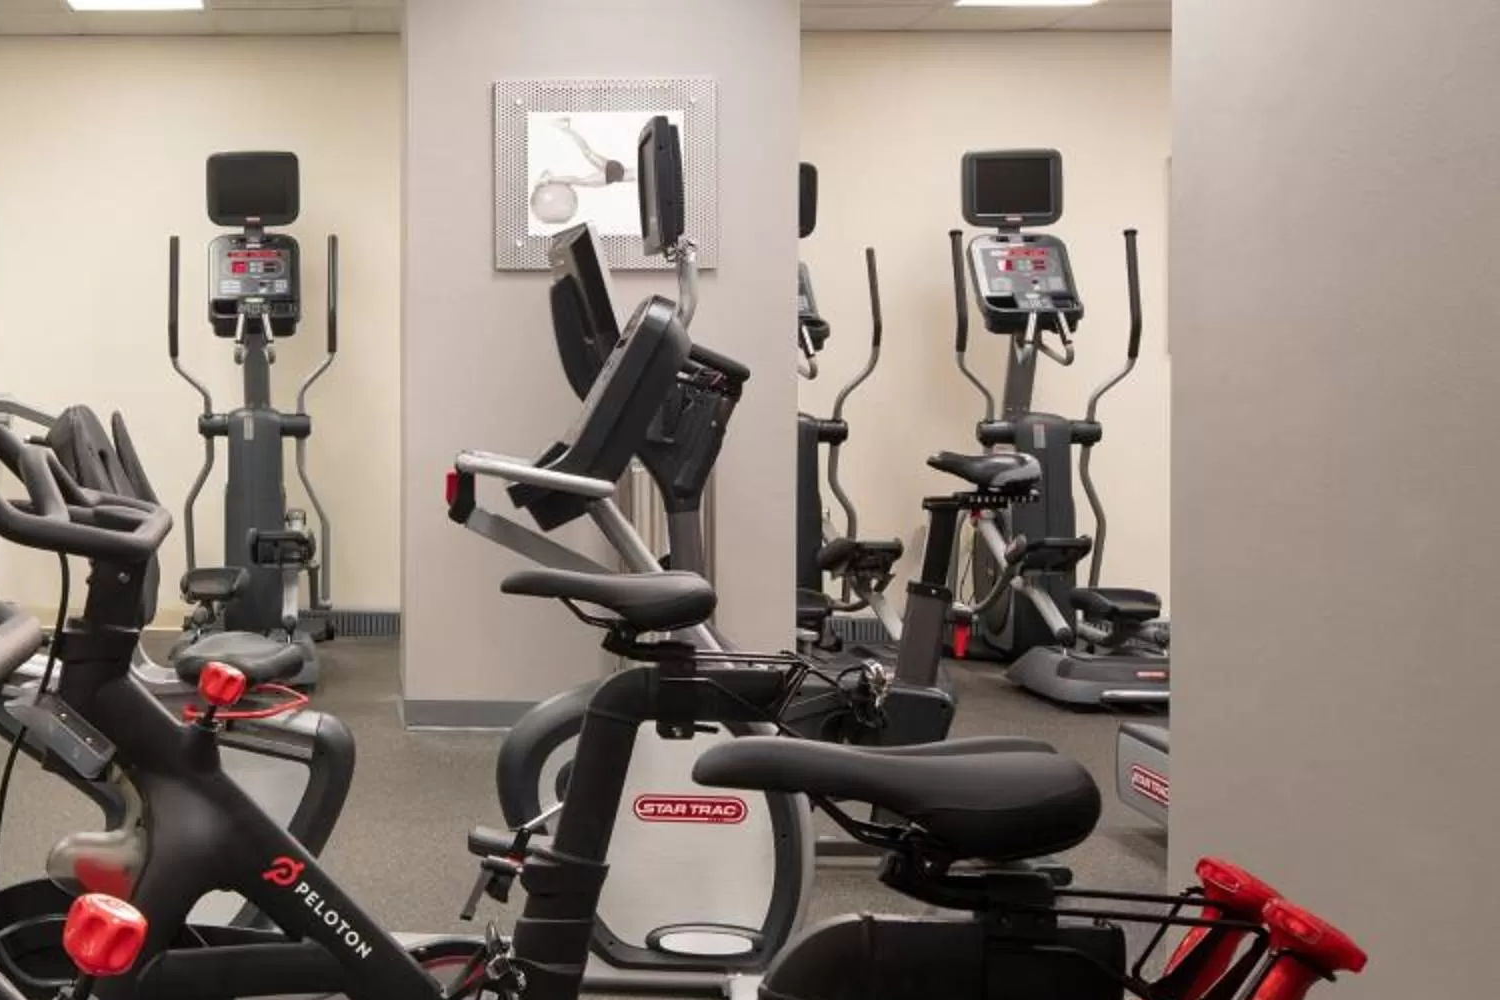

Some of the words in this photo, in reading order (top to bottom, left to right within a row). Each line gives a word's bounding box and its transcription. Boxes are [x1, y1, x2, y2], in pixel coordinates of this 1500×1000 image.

[640, 803, 686, 815] STAR
[689, 804, 738, 816] TRAC
[293, 880, 373, 960] PELOTON
